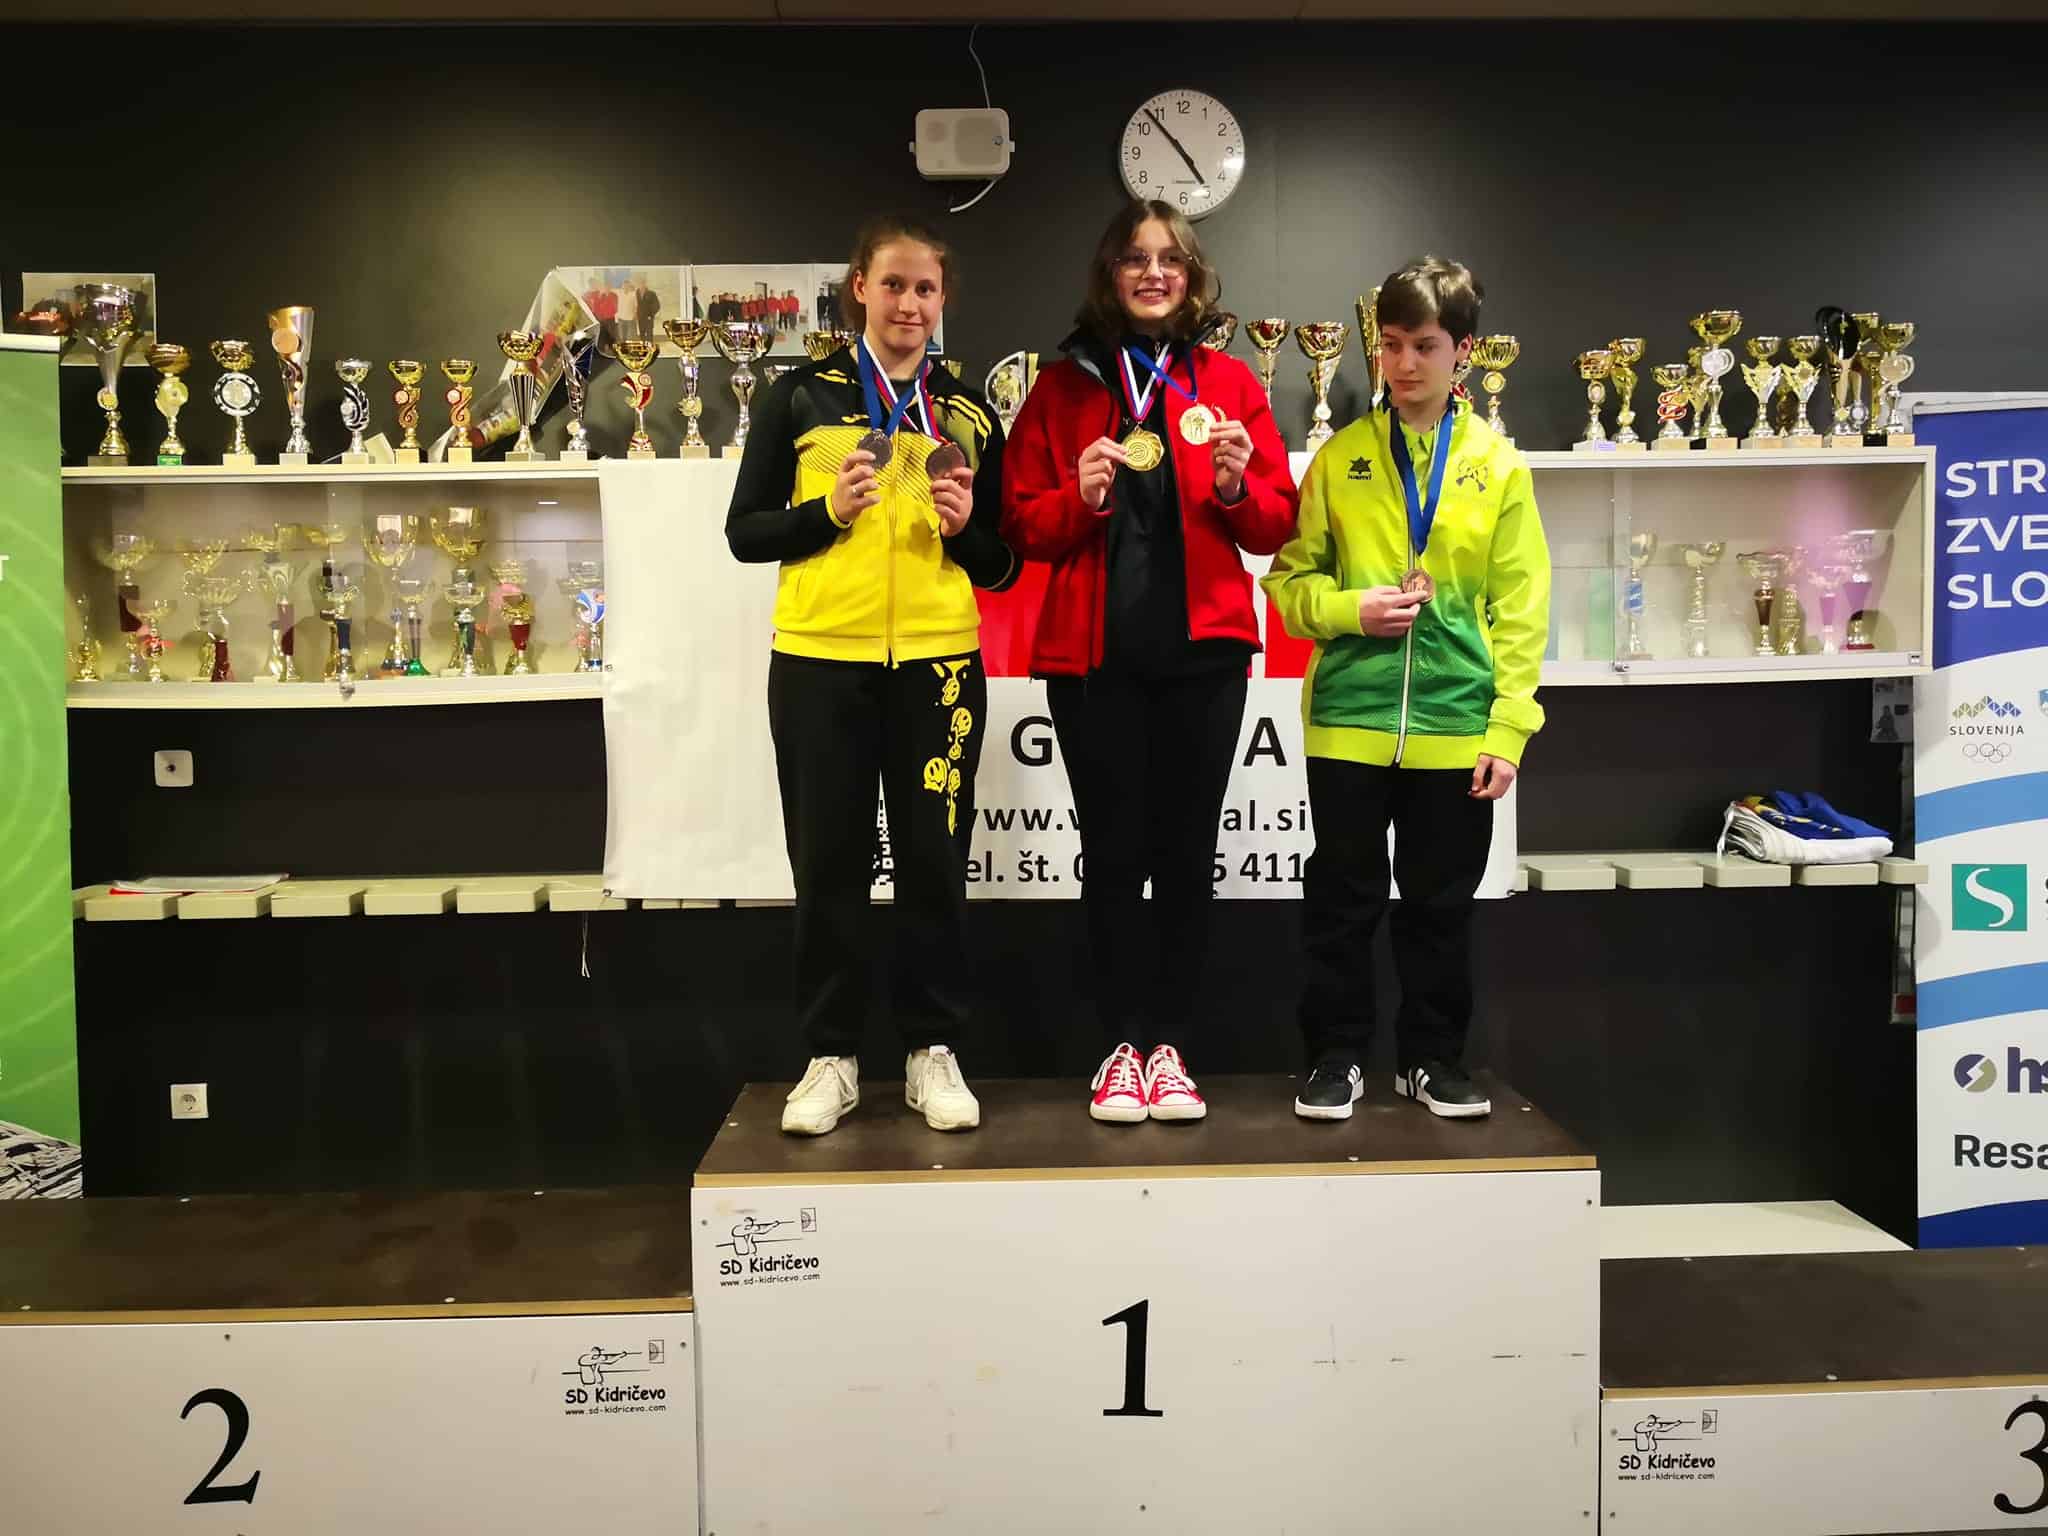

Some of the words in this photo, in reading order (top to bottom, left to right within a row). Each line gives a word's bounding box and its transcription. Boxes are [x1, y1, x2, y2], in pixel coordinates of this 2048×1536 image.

[1155, 107, 1165, 120] 11
[1176, 100, 1191, 114] 12
[1201, 108, 1208, 120] 1
[1137, 122, 1151, 136] 10
[1217, 123, 1227, 137] 2
[1131, 147, 1141, 160] 9
[1225, 146, 1234, 158] 3
[1139, 170, 1148, 184] 8
[1217, 170, 1226, 182] 4
[1155, 186, 1165, 198] 7
[1179, 191, 1188, 205] 6
[1945, 458, 2048, 498] STR
[1946, 514, 2048, 554] ZVE
[1946, 571, 2048, 610] SLO
[1949, 725, 2025, 736] SLOVENIJA
[1018, 850, 1060, 882] št.
[719, 1260, 743, 1275] SD
[750, 1253, 820, 1273] Kidričevo
[720, 1272, 821, 1287] www.sd-kidricevo.com
[1103, 1300, 1163, 1417] 1
[565, 1389, 588, 1404] SD
[595, 1385, 666, 1403] Kidričevo
[565, 1404, 666, 1415] www.sd-kidricevo.com
[181, 1389, 260, 1504] 2
[1618, 1455, 1641, 1470] SD
[1648, 1453, 1716, 1469] Kidričevo
[1994, 1400, 2048, 1514] 3
[1618, 1472, 1715, 1481] www.sd-kidricevo.com
